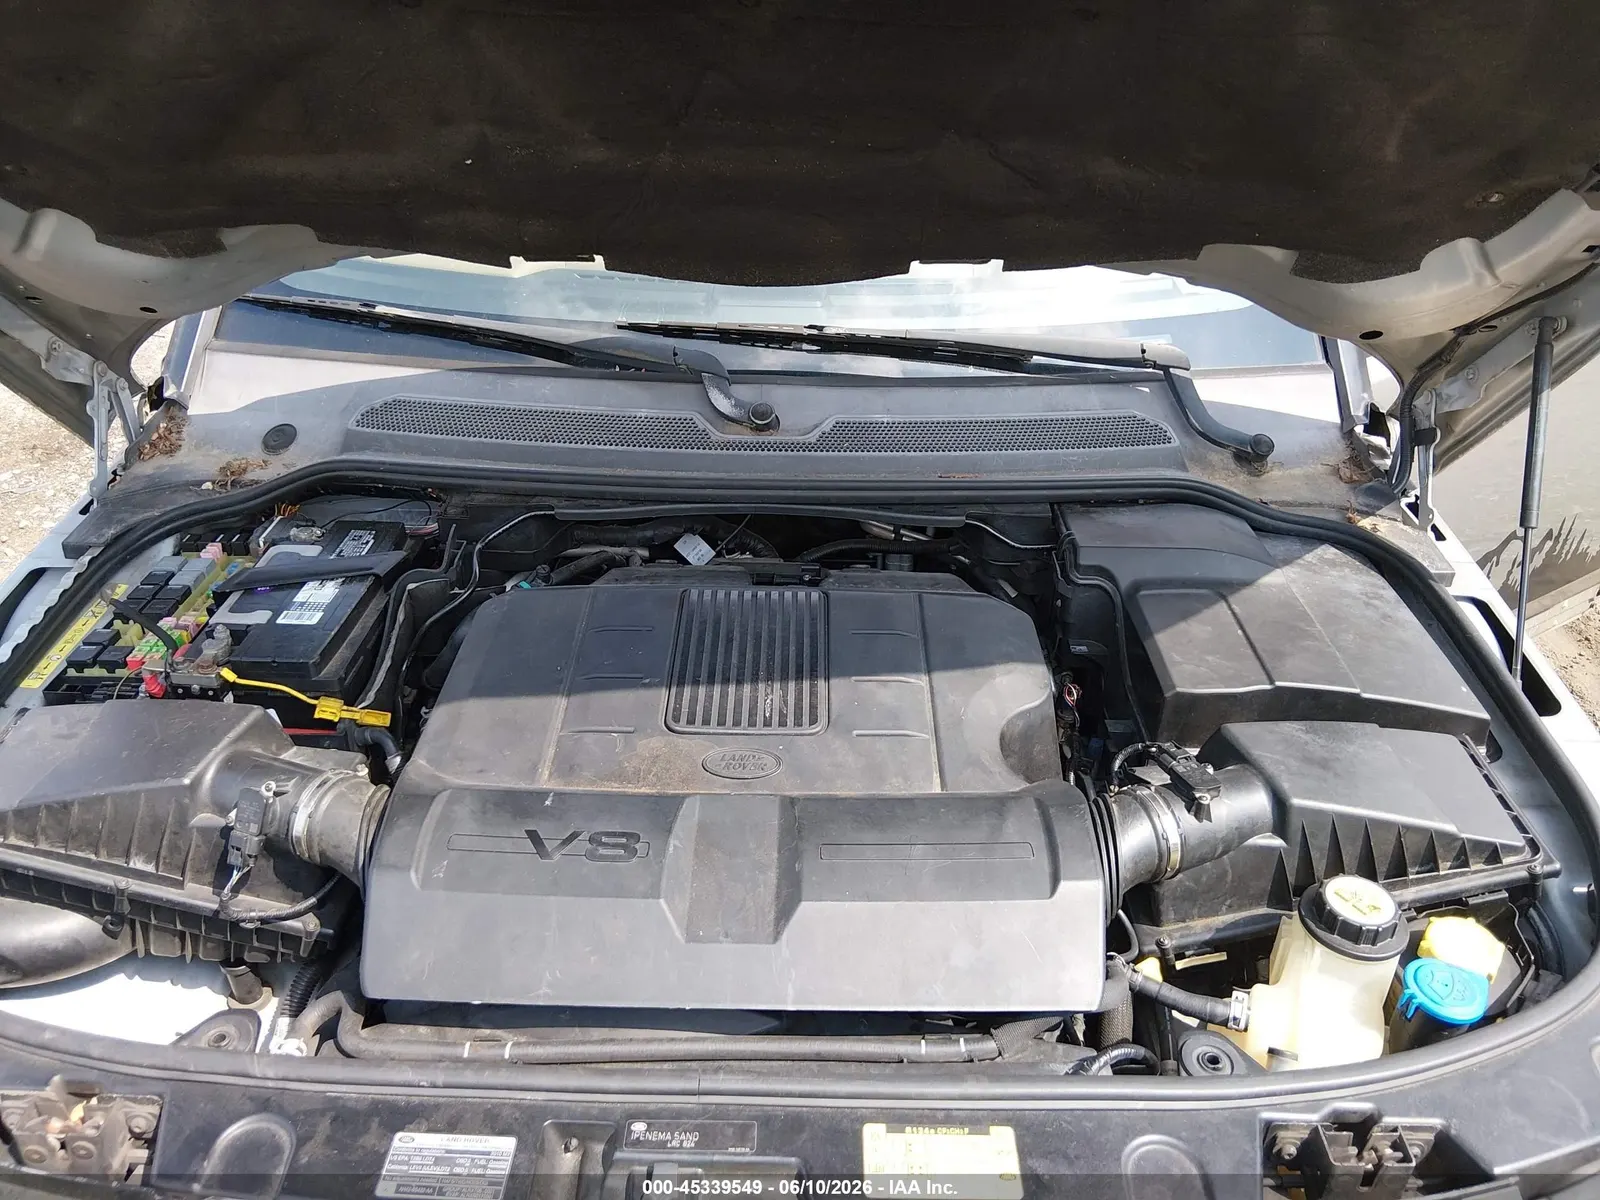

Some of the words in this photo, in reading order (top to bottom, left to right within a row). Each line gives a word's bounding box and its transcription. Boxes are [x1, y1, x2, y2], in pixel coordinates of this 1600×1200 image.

[719, 752, 761, 763] LAND
[721, 761, 768, 772] ROVER
[523, 828, 642, 863] V8
[673, 1131, 700, 1141] SAND
